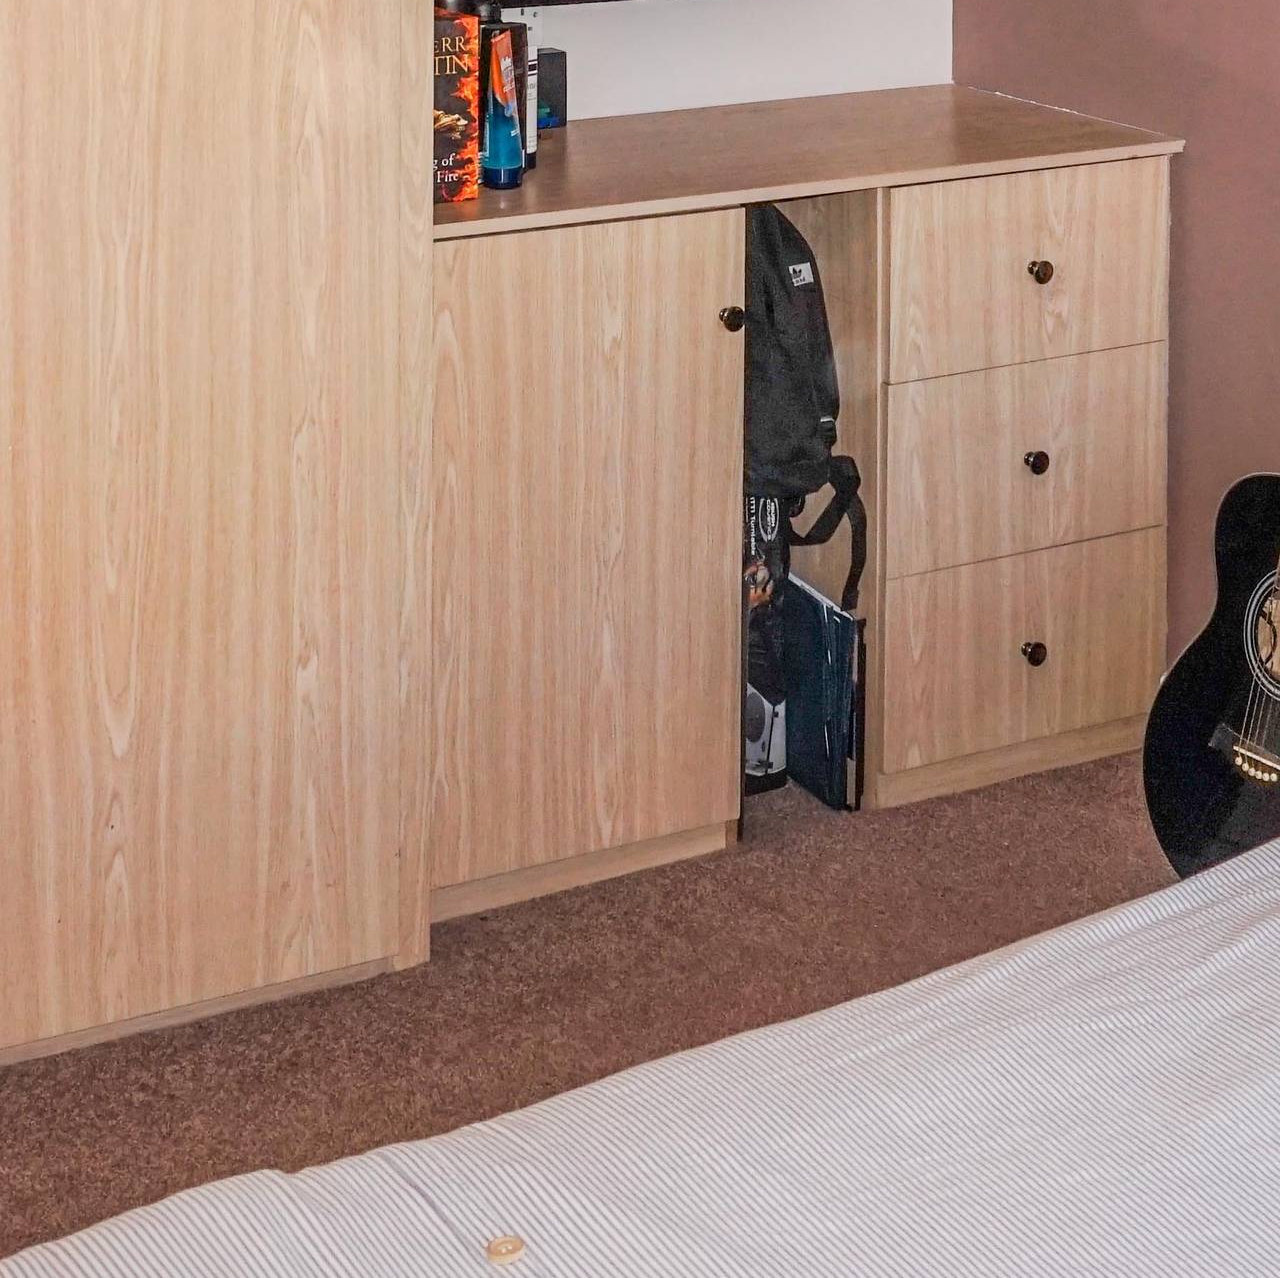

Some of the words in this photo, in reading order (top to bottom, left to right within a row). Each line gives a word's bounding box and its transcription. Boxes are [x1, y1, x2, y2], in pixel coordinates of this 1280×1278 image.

[434, 54, 470, 75] TIN
[441, 153, 455, 166] of
[437, 170, 459, 182] Fire
